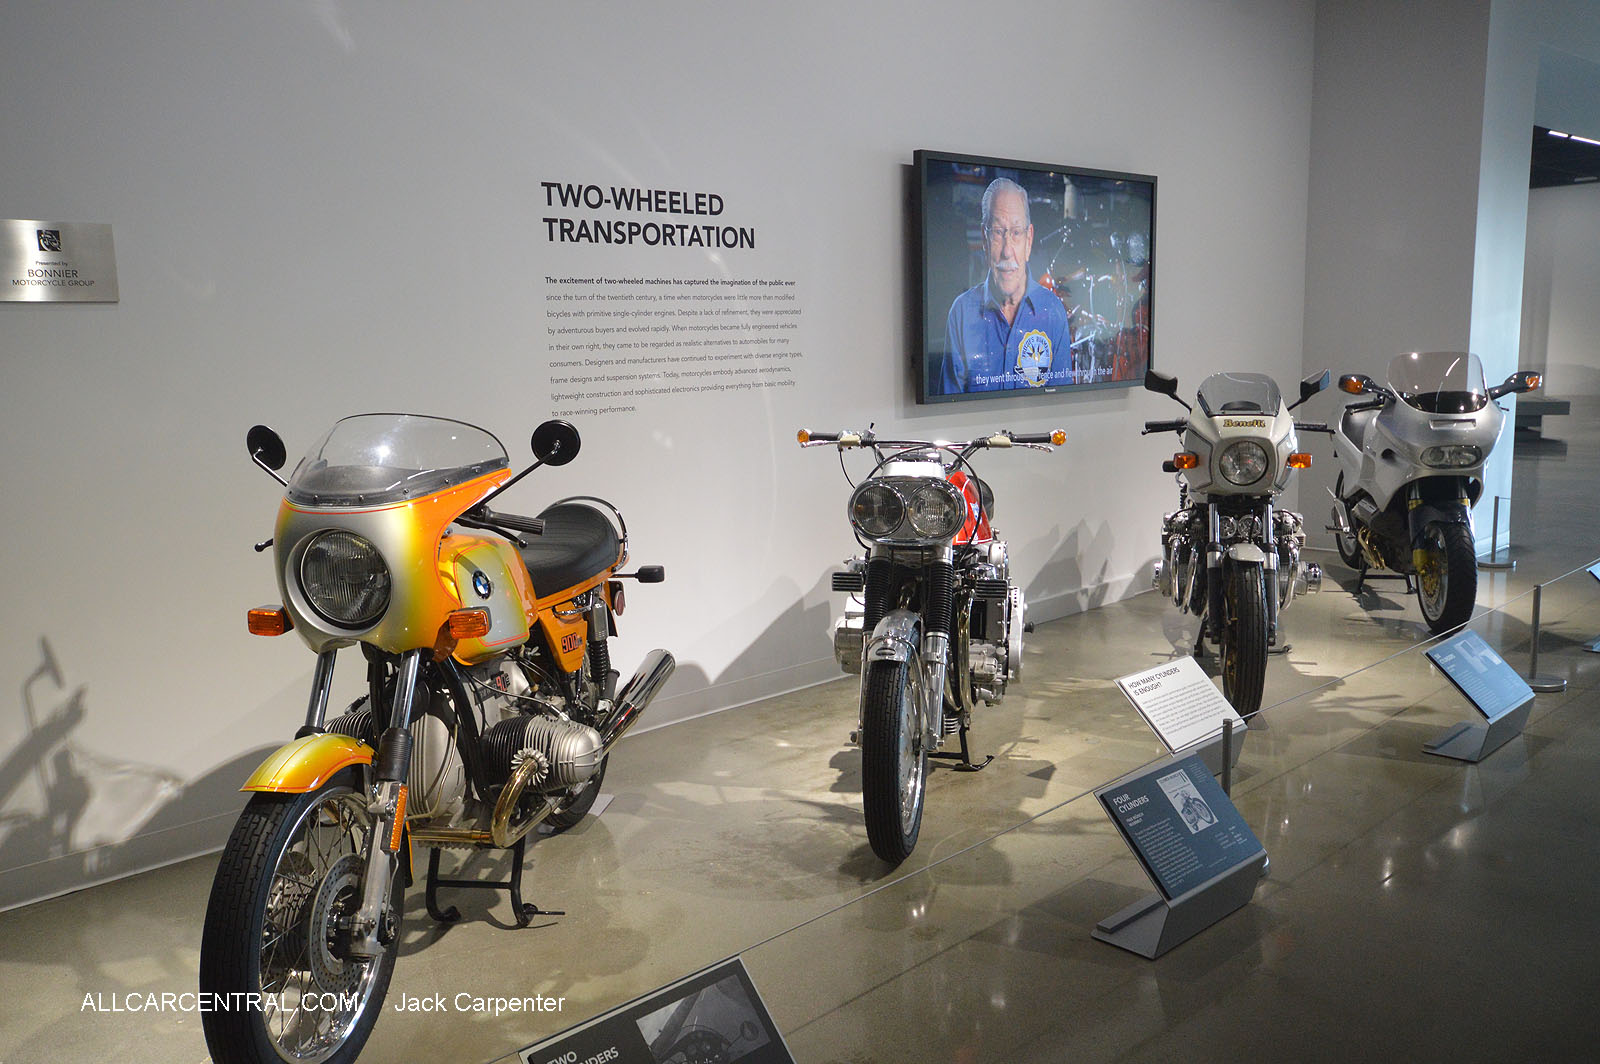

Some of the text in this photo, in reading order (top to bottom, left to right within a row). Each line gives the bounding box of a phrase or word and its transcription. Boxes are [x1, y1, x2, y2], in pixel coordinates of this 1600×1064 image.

[541, 181, 724, 216] TWO-WHEELED
[543, 217, 755, 249] TRANSPORTATION
[28, 269, 78, 278] BONNIER
[12, 279, 66, 287] MOTORCYCLE
[559, 277, 594, 285] excitement
[604, 277, 643, 285] two-wheeled
[684, 279, 708, 287] captured
[720, 279, 751, 287] imagination
[769, 279, 784, 287] public
[563, 293, 572, 301] the
[588, 293, 594, 301] of
[596, 293, 606, 301] the
[692, 294, 723, 302] motorcycles
[546, 310, 571, 319] bicycles
[586, 310, 611, 319] primitive
[613, 309, 652, 319] single-cylinder
[654, 310, 676, 318] engines.
[677, 309, 698, 318] Despite
[721, 308, 749, 317] refinement,
[750, 309, 760, 317] they
[775, 308, 801, 317] appreciated
[547, 327, 555, 336] by
[595, 326, 615, 335] buyers
[651, 325, 671, 334] rapidly.
[688, 324, 719, 333] motorcycles
[720, 323, 740, 331] became
[741, 323, 751, 332] fully
[752, 323, 778, 332] engineered
[779, 322, 798, 330] vehicles
[556, 343, 569, 351] their
[585, 343, 601, 352] right,
[602, 342, 616, 352] they
[649, 341, 674, 350] regarded
[683, 339, 702, 347] realistic
[777, 338, 790, 346] many
[584, 358, 614, 368] Designers
[627, 356, 666, 364] manufacturers
[714, 354, 743, 363] experiment
[772, 352, 788, 360] engine
[789, 351, 803, 359] types,
[550, 365, 792, 385] frame designs and suspension systems. Today, motorcycles embody advanced aerodynamics,
[976, 374, 989, 387] they
[990, 373, 1004, 383] went
[1054, 367, 1065, 379] and
[1097, 366, 1106, 376] the
[550, 379, 796, 402] lightweight construction and sophisticated electronics providing everything from basic mobility
[560, 408, 598, 418] race-winning
[599, 405, 636, 415] performance.
[1128, 666, 1180, 689] HOW MANY CYLINDERS
[1133, 681, 1163, 697] IS ENOUGH?
[1112, 792, 1131, 806] FOUR
[1118, 795, 1150, 814] CYLINDERS
